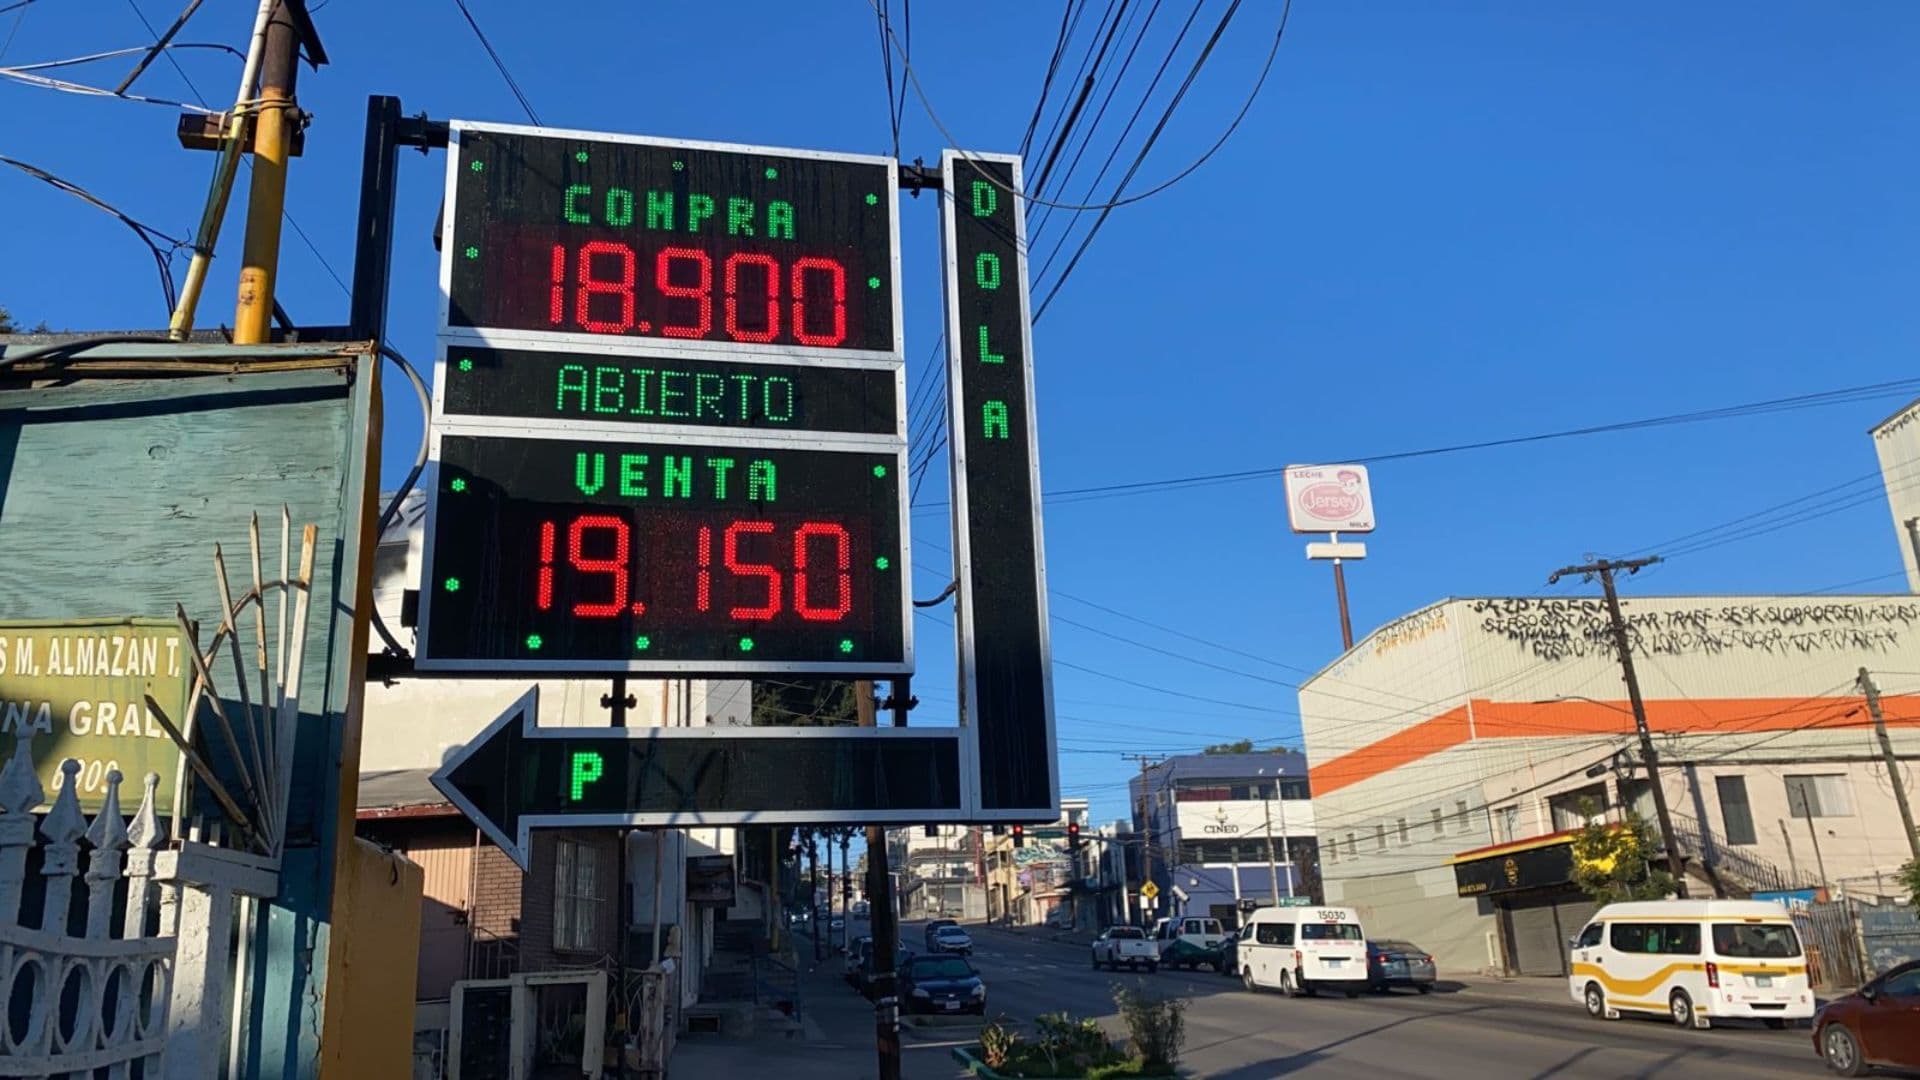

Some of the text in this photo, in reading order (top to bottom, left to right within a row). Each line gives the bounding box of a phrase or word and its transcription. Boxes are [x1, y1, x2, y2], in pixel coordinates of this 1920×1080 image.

[563, 184, 796, 240] COMPRA
[549, 241, 847, 347] 18.900
[556, 364, 794, 422] ABIERTO
[574, 452, 777, 502] VENTA
[1294, 471, 1323, 479] LECHE
[1307, 488, 1358, 510] Jersey
[537, 515, 852, 621] 19.150
[15, 637, 40, 676] M.
[47, 637, 158, 677] ALMAZAN
[166, 637, 180, 678] T.
[571, 752, 603, 800] P
[1204, 824, 1239, 834] CINEO
[1317, 910, 1346, 920] 15030
